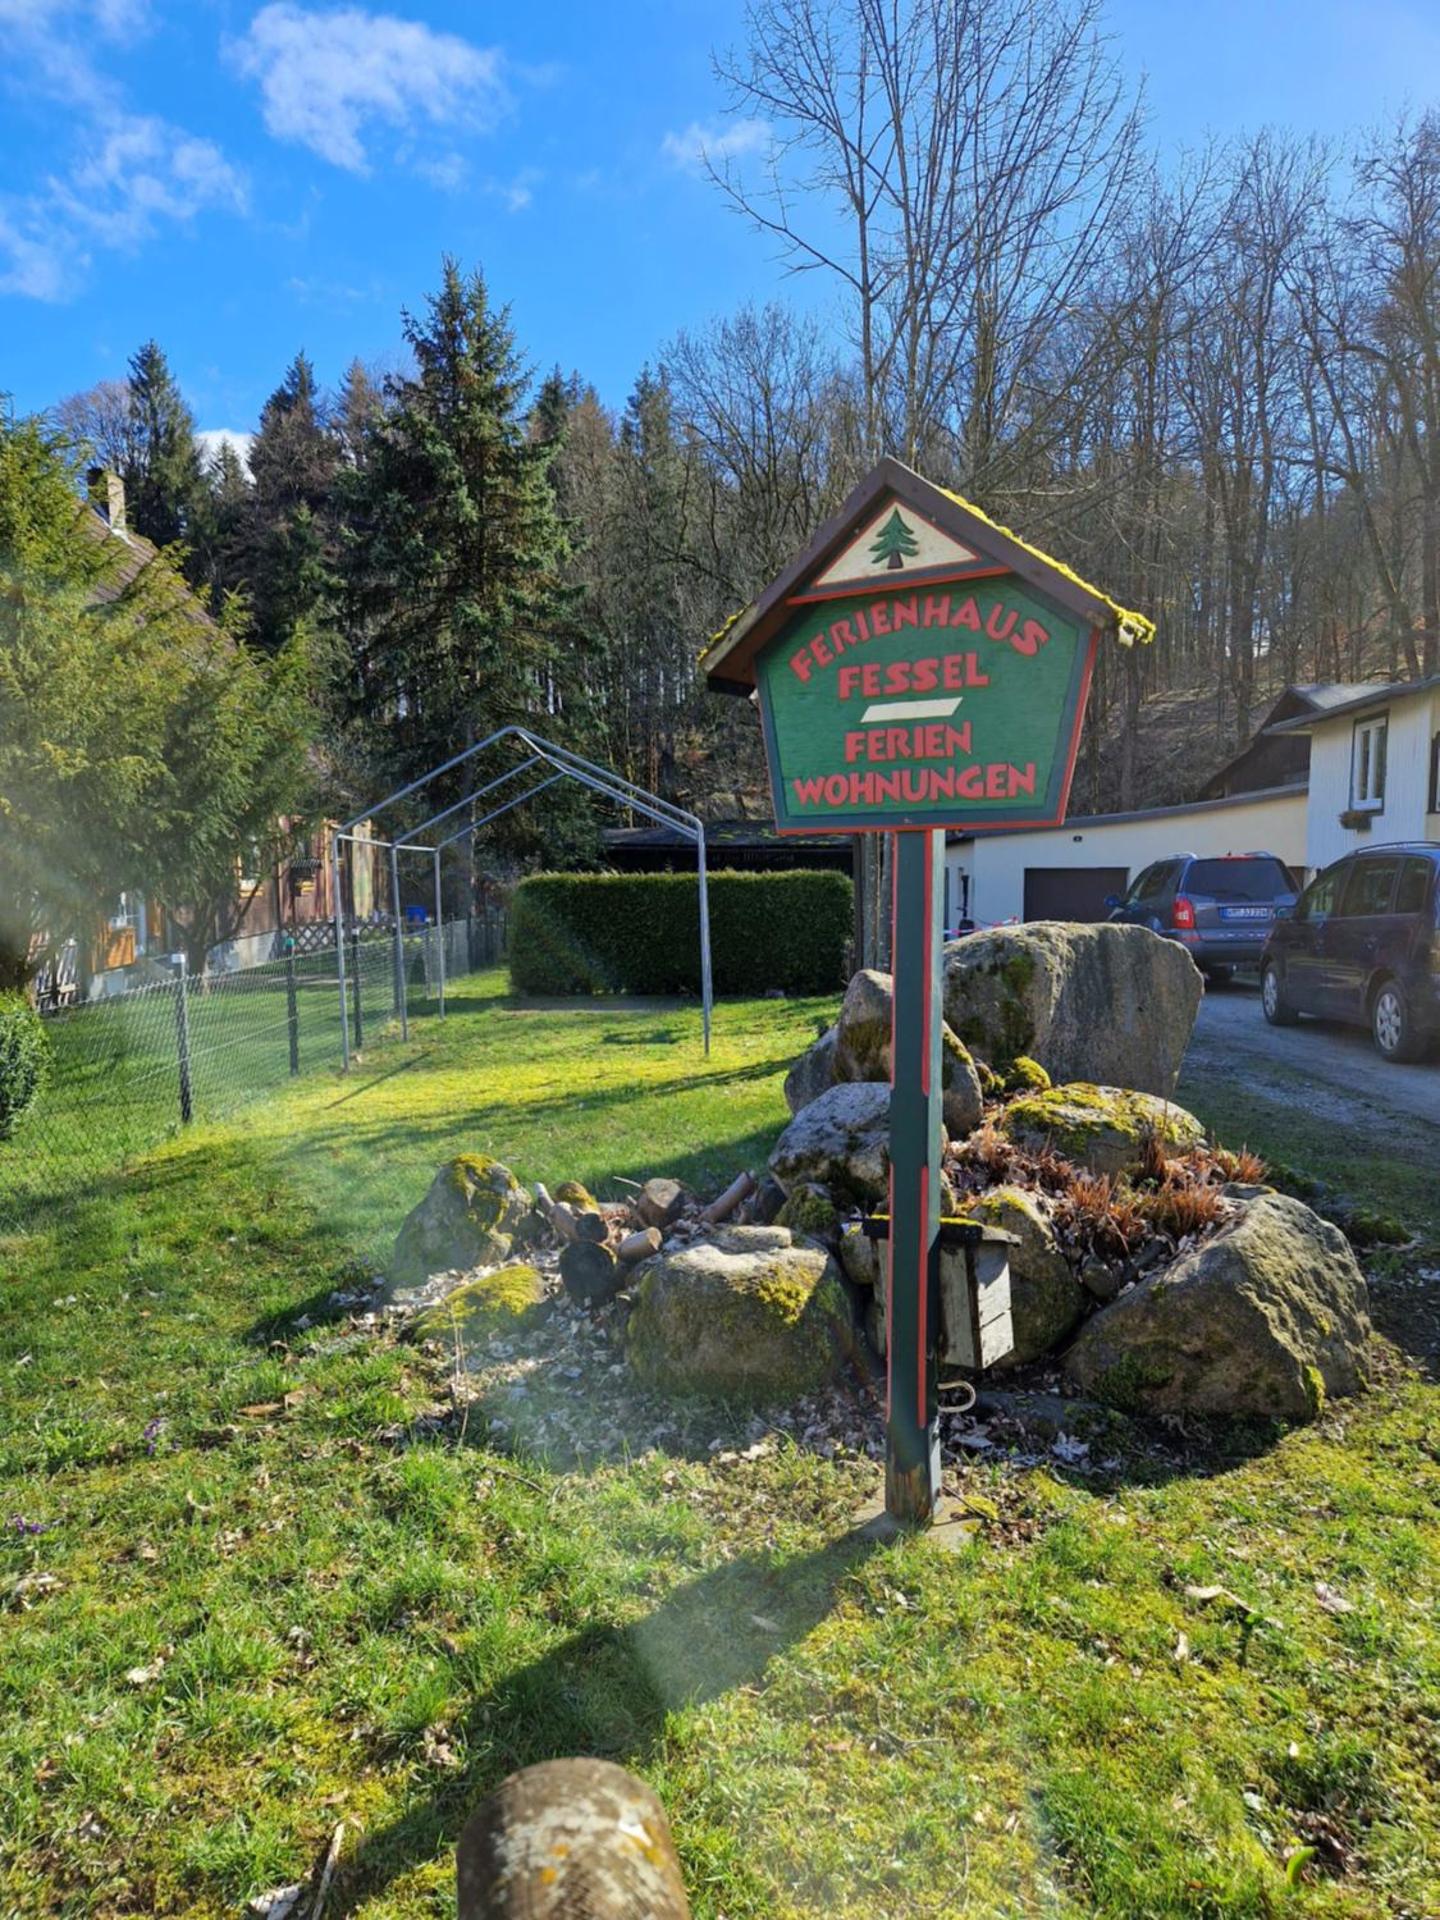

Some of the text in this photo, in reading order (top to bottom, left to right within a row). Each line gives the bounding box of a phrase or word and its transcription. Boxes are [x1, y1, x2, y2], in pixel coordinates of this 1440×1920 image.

[789, 595, 1050, 682] FERIENHAUS
[838, 652, 990, 699] FESSEL
[845, 721, 972, 763] FERIEN
[793, 763, 1036, 806] WOHNUNGEN
